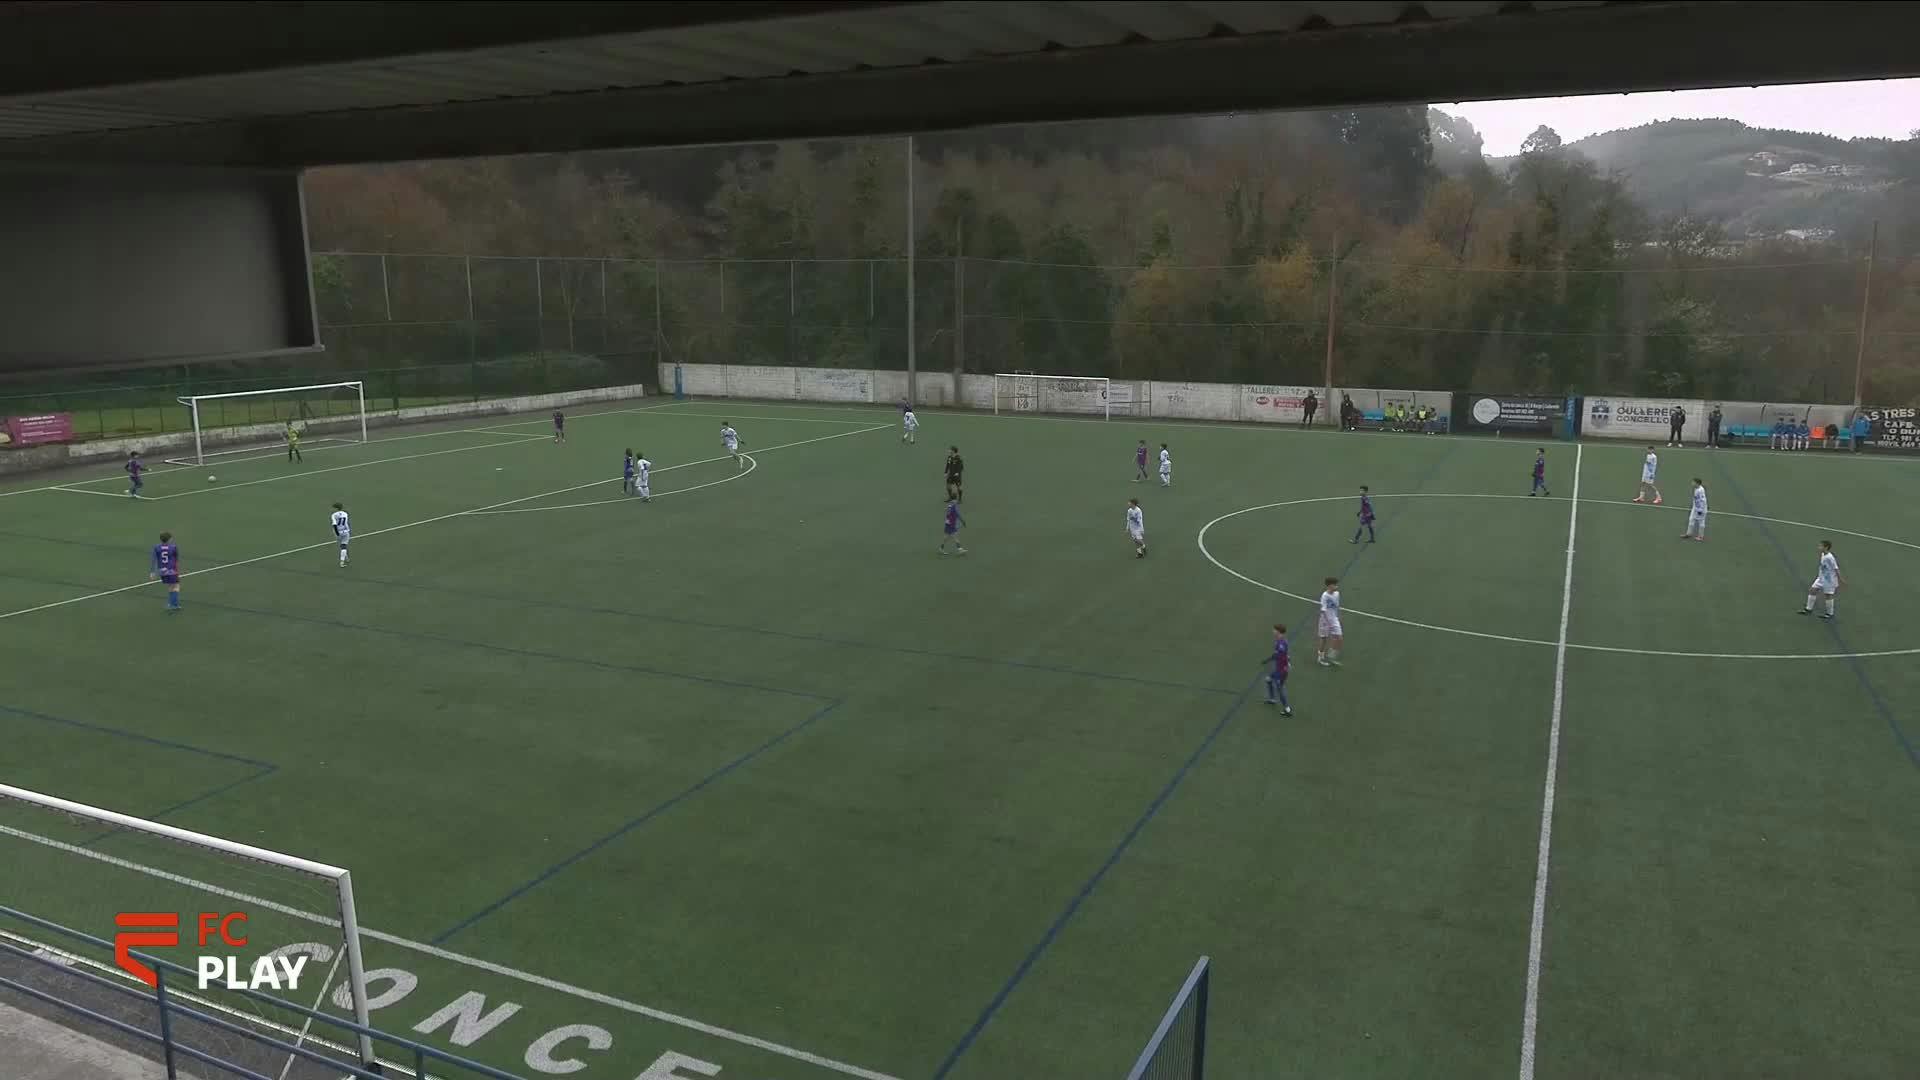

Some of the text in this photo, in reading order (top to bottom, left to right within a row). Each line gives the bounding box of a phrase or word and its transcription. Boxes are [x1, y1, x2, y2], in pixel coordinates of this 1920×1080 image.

[1616, 407, 1686, 417] CULLERED
[1882, 408, 1916, 419] TRES
[1616, 415, 1670, 424] CONCELLO
[161, 551, 169, 564] 5
